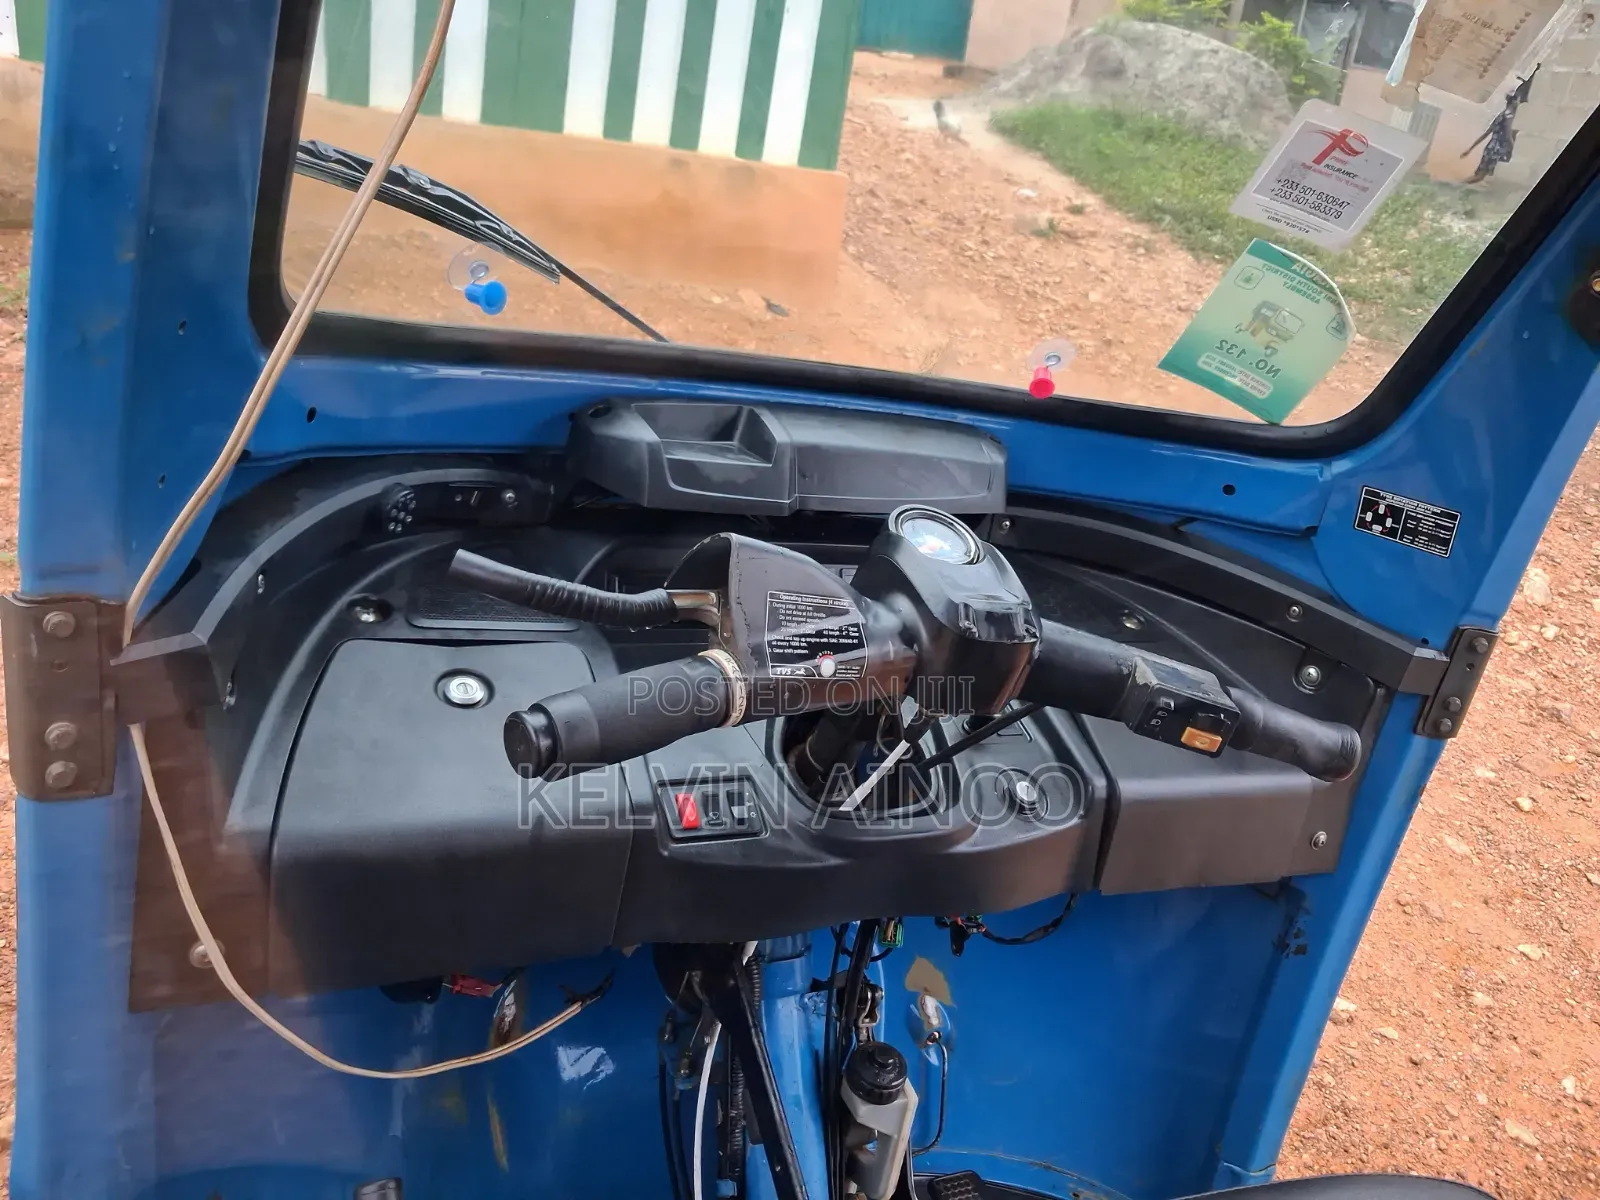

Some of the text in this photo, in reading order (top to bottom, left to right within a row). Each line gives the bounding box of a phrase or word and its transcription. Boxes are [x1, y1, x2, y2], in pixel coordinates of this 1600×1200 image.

[1323, 163, 1358, 180] INSURANCE
[1276, 178, 1351, 211] +233 501-630647
[1270, 187, 1343, 220] +233 501-583379
[780, 594, 802, 603] Operating
[802, 596, 828, 605] Instructions
[776, 667, 791, 675] TVS
